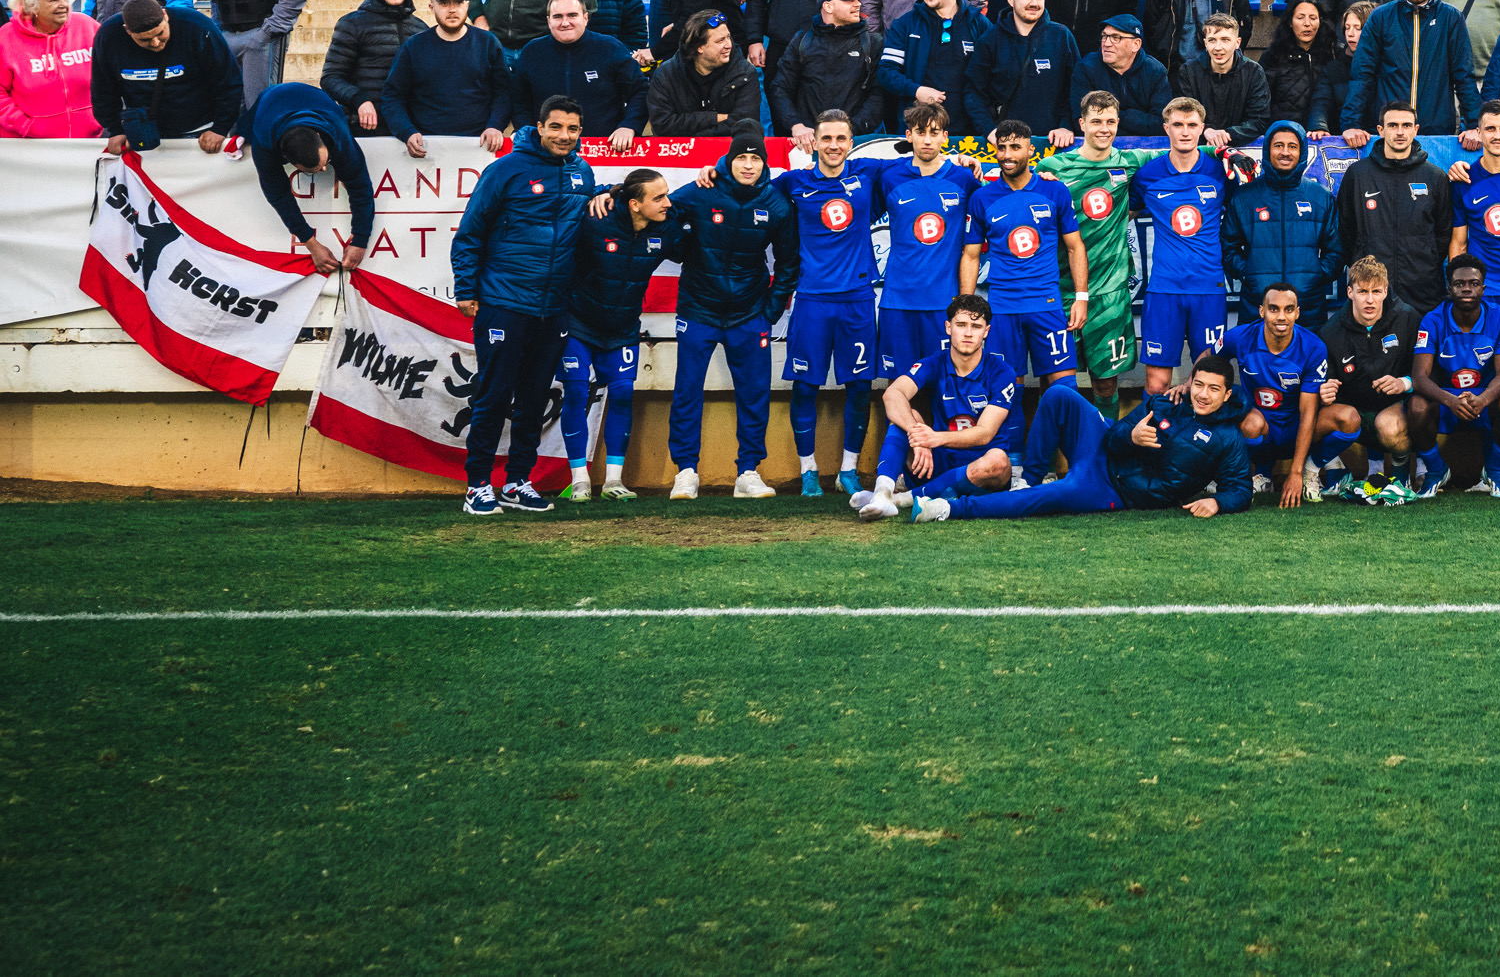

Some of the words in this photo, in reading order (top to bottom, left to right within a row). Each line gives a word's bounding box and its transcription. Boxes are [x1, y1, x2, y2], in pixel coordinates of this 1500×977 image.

[290, 168, 481, 200] GAND
[827, 204, 847, 225] B
[1090, 194, 1107, 215] B
[920, 218, 939, 239] B
[1178, 210, 1196, 231] B
[291, 227, 459, 260] HYAT
[1015, 232, 1032, 253] B
[168, 258, 278, 324] HORST
[1046, 330, 1068, 356] 17
[1108, 336, 1128, 362] 12
[622, 346, 634, 364] 6
[854, 342, 867, 366] 2
[1458, 374, 1474, 388] B
[1259, 391, 1275, 407] B
